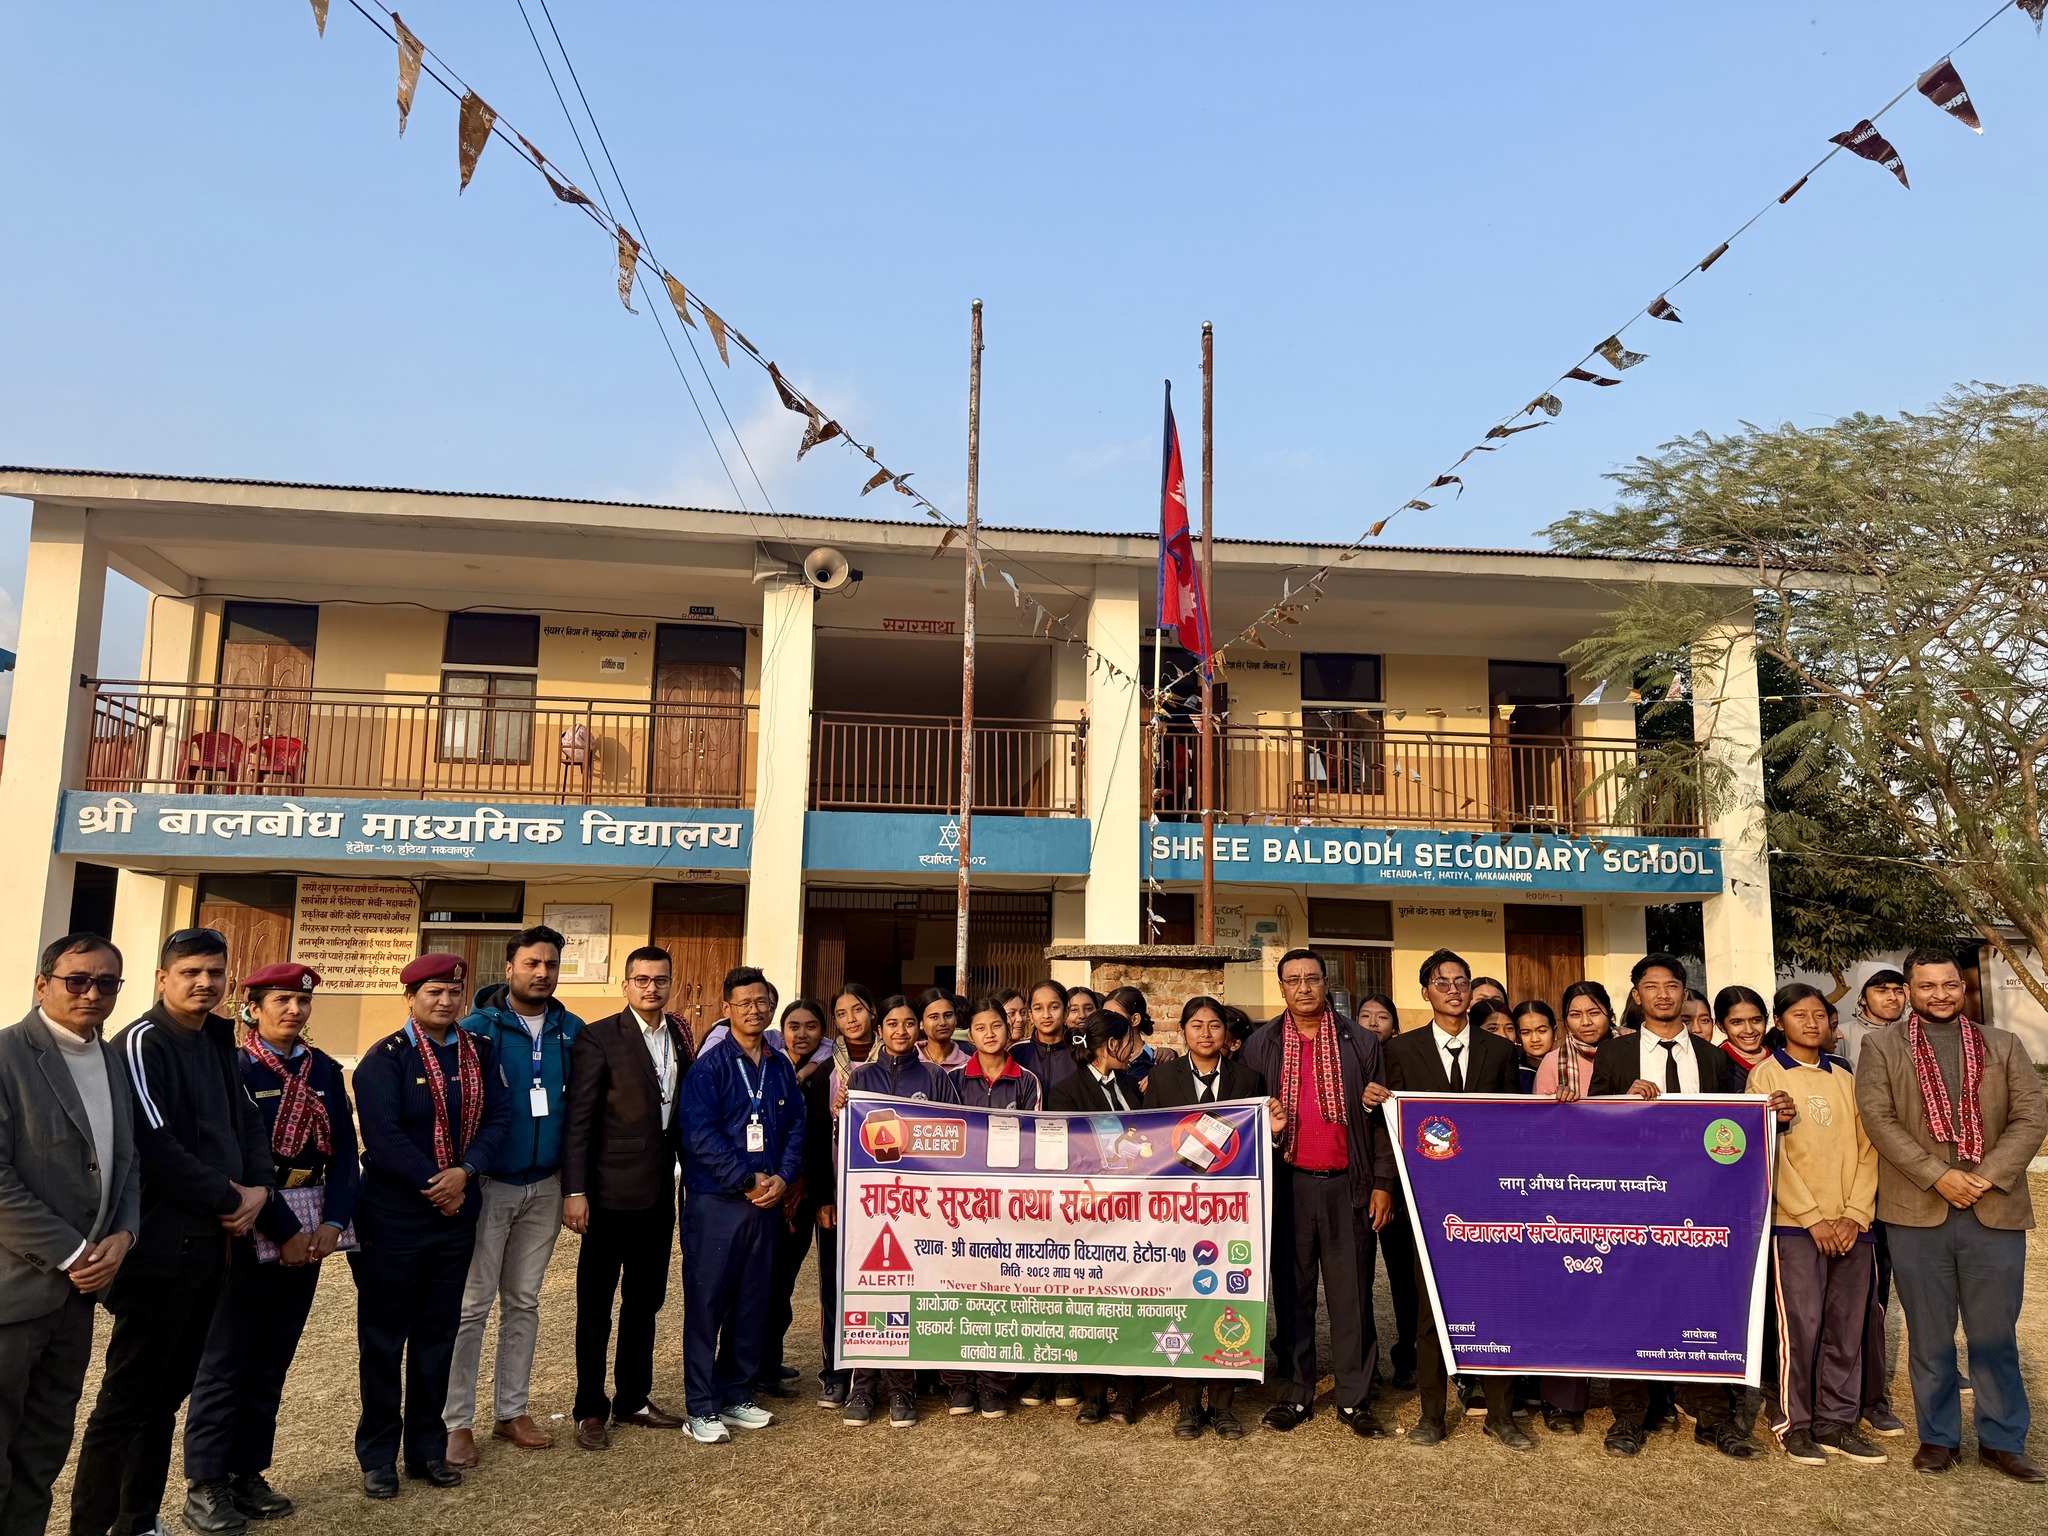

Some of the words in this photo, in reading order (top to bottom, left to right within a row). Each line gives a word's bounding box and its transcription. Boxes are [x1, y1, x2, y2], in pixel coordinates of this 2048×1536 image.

[883, 618, 955, 634] सगरमाथा
[79, 797, 138, 834] श्री
[158, 802, 344, 840] बालबोध
[362, 806, 564, 844] माध्यमिक
[580, 810, 743, 850] विद्यालय
[431, 845, 476, 858] मकवानपुर
[1152, 836, 1250, 862] SHREE
[1263, 838, 1402, 866] BALBODH
[1415, 843, 1590, 872] SECONDARY
[1604, 848, 1714, 875] SCHOOL
[1380, 870, 1435, 880] HETAUDA-17,
[1438, 871, 1472, 881] HATIYA,
[1475, 872, 1532, 882] MAKAWANPUR
[912, 1125, 959, 1138] SCAM
[912, 1139, 959, 1152] ALERT
[1499, 1176, 1528, 1195] लागू
[1529, 1173, 1565, 1190] औषध
[1568, 1174, 1617, 1192] नियन्त्रण
[1620, 1175, 1668, 1192] सम्बन्धि
[860, 1176, 932, 1220] साईबर
[937, 1187, 1003, 1229] सुरक्षा
[1008, 1188, 1053, 1222] तथा
[1060, 1180, 1142, 1225] सचेतना
[1148, 1182, 1250, 1226] कार्यक्रम
[1444, 1214, 1524, 1244] विद्यालय
[1526, 1215, 1648, 1254] सचेतनामुलक
[1650, 1218, 1730, 1248] कार्यक्रम
[914, 1239, 948, 1256] स्थान-
[952, 1237, 966, 1258] श्री
[969, 1238, 1012, 1259] बालबोध
[1016, 1238, 1071, 1261] माध्यमिक
[1000, 1263, 1024, 1277] मिति-
[1026, 1266, 1050, 1278] २०८२
[1074, 1268, 1085, 1279] १५
[1088, 1265, 1103, 1280] गते
[1563, 1256, 1603, 1274] २०८२
[858, 1274, 914, 1286] ALERT!!
[940, 1280, 978, 1290] "Never
[980, 1282, 1010, 1292] Share
[1014, 1283, 1042, 1293] Your
[1044, 1284, 1070, 1294] OTP
[1088, 1286, 1172, 1297] PASSWORDS"
[916, 1294, 962, 1312] आयोजक-
[1010, 1297, 1062, 1316] एसोसिएसन
[1066, 1298, 1094, 1316] नेपाल
[1097, 1301, 1134, 1319] महासंघ,
[1137, 1304, 1188, 1322] मकवानपुर
[844, 1330, 909, 1339] Federation
[916, 1319, 956, 1336] सहकार्य-
[960, 1317, 992, 1336] जिल्ला
[995, 1318, 1018, 1337] प्रहरी
[1021, 1320, 1066, 1340] कार्यालय,
[1069, 1326, 1120, 1344] मकवानपुर
[1448, 1322, 1476, 1334] सहकार्य
[1682, 1328, 1717, 1340] आयोजक
[844, 1339, 909, 1347] Makwanpur
[960, 1342, 997, 1360] बालबोध
[1668, 1348, 1686, 1361] प्रदेश
[1688, 1350, 1706, 1361] प्रहरी
[1708, 1350, 1746, 1364] कार्यालय,
